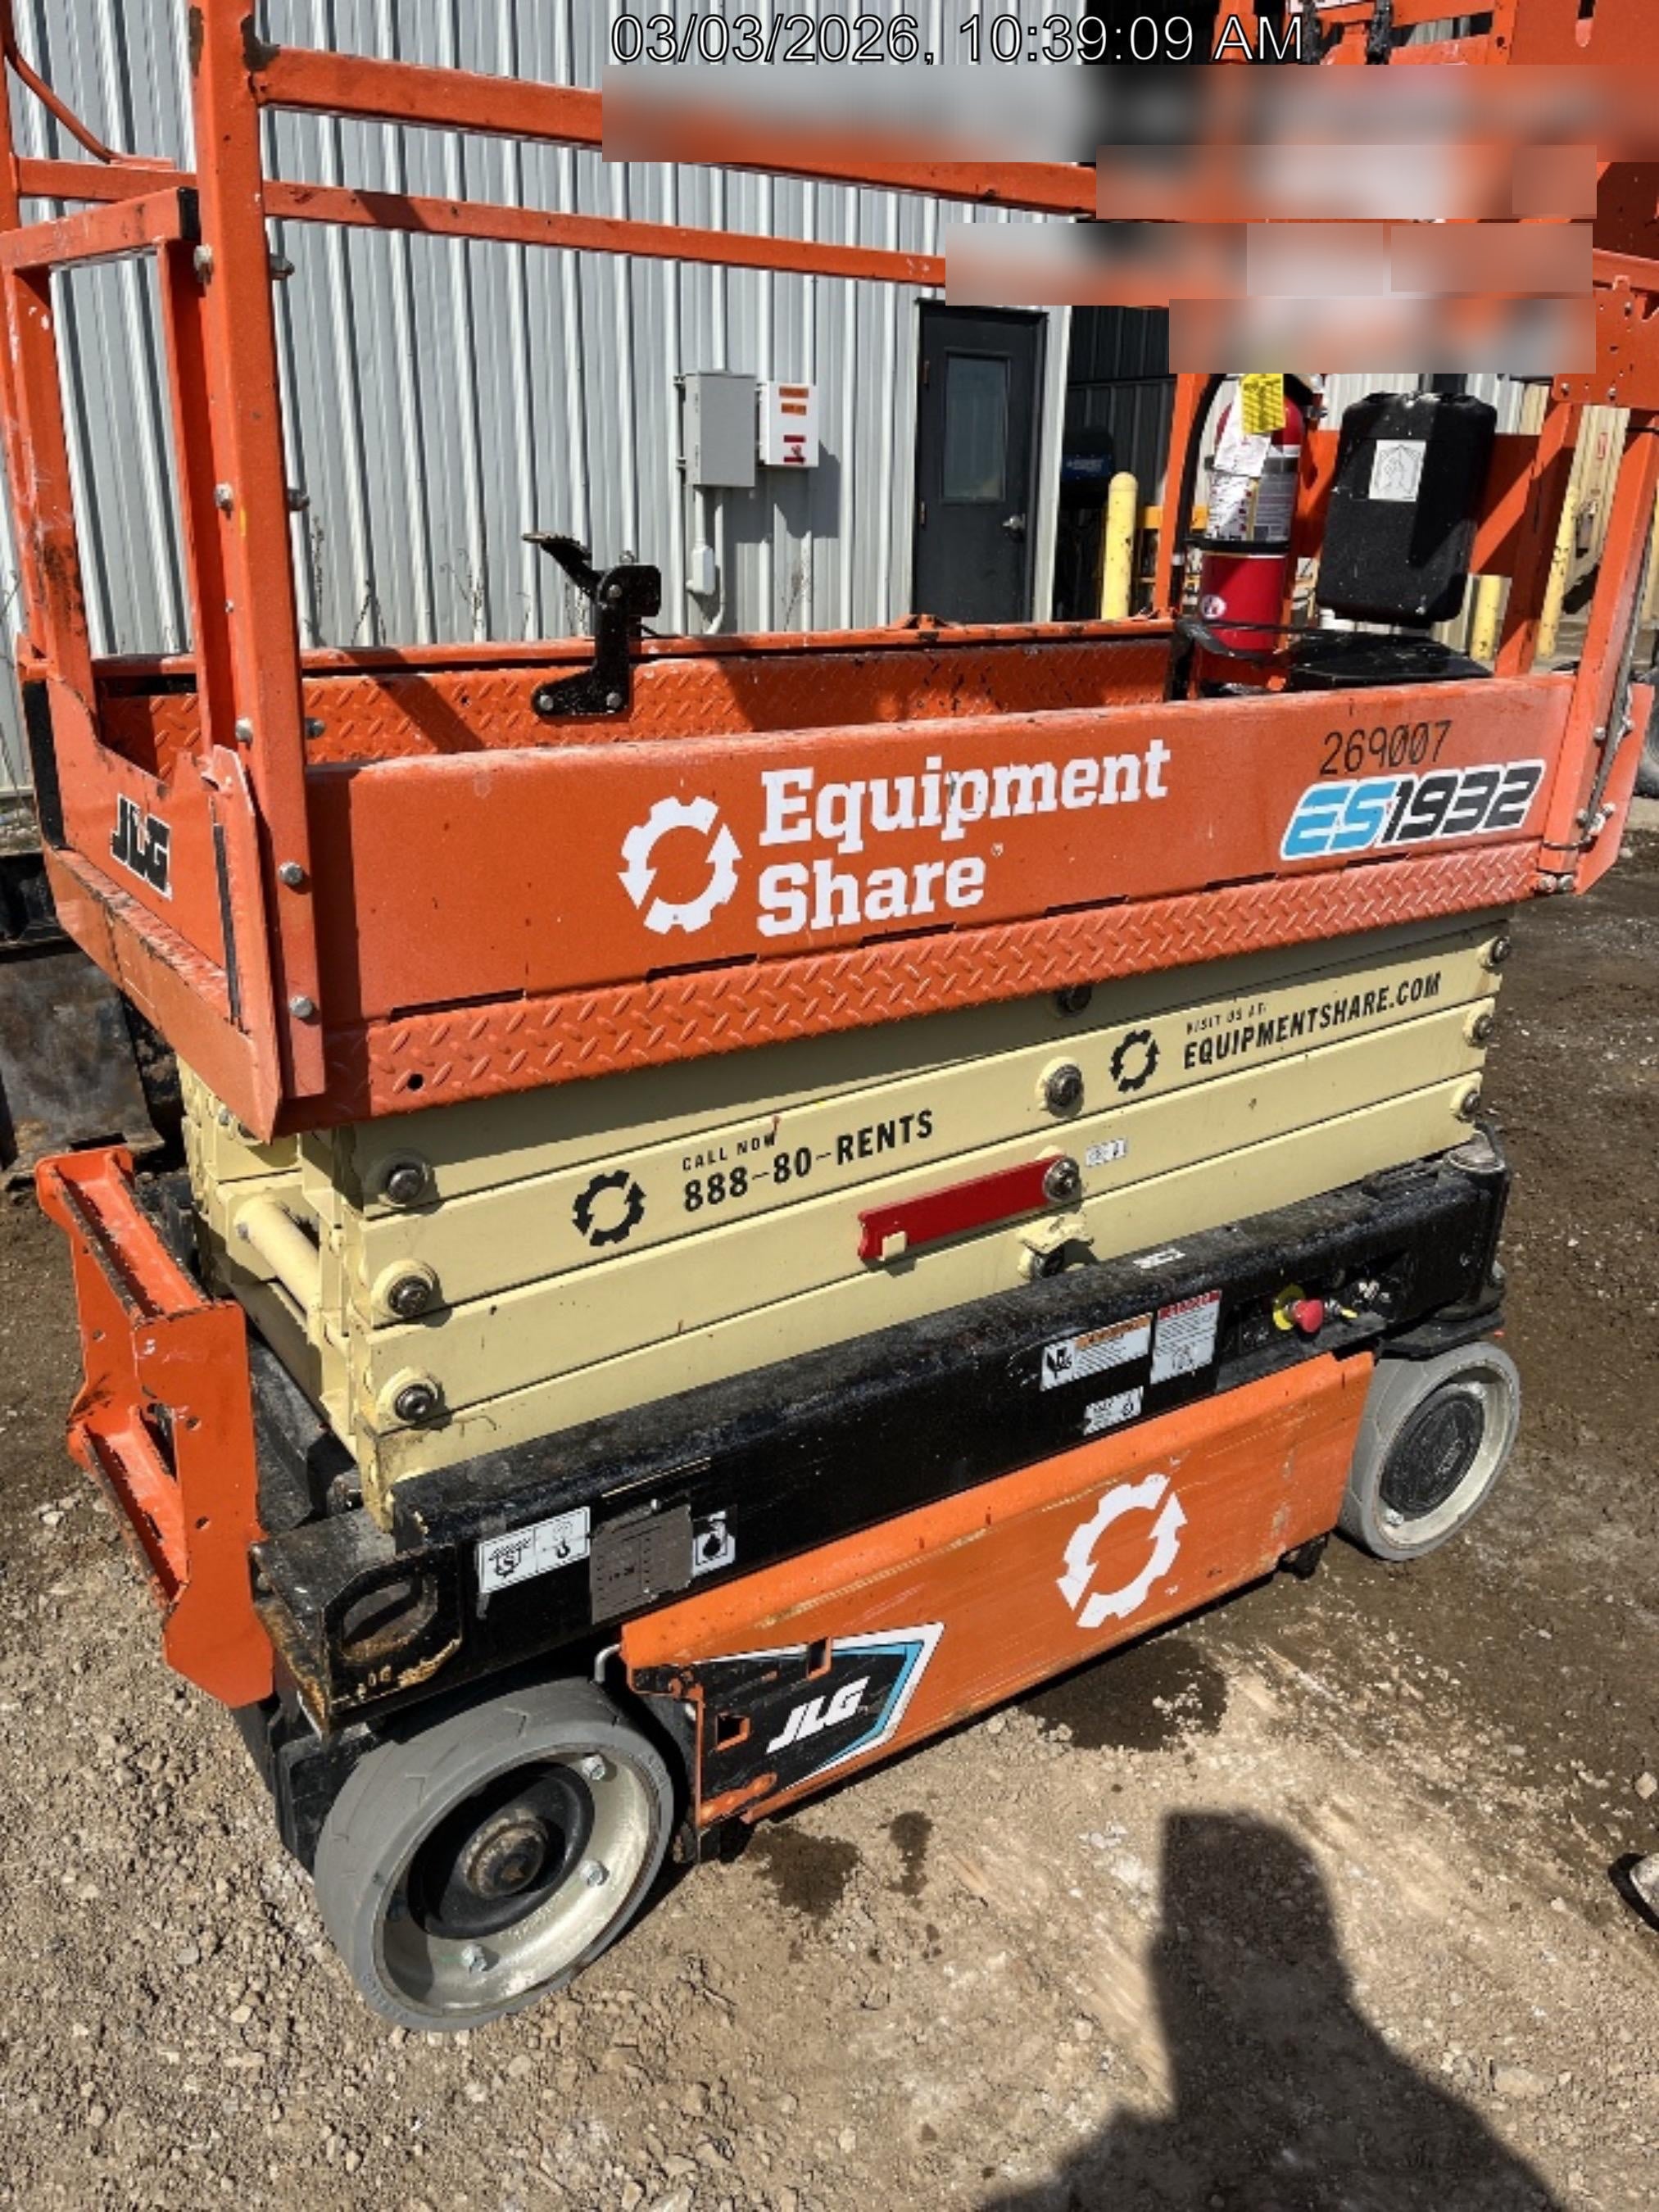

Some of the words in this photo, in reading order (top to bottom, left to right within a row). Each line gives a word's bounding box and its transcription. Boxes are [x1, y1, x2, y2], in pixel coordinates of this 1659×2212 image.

[759, 739, 1171, 854] Equipment
[1320, 720, 1451, 776] 269007
[110, 793, 173, 902] JLG
[1281, 759, 1547, 860] ES1932
[757, 856, 986, 937] Share
[1183, 972, 1442, 1069] EQUIPMENTSHARE.COM
[682, 1147, 728, 1172] CALL
[737, 1131, 777, 1155] NOW
[684, 1109, 932, 1213] 888-80-RENTS
[766, 1676, 871, 1754] JLG
